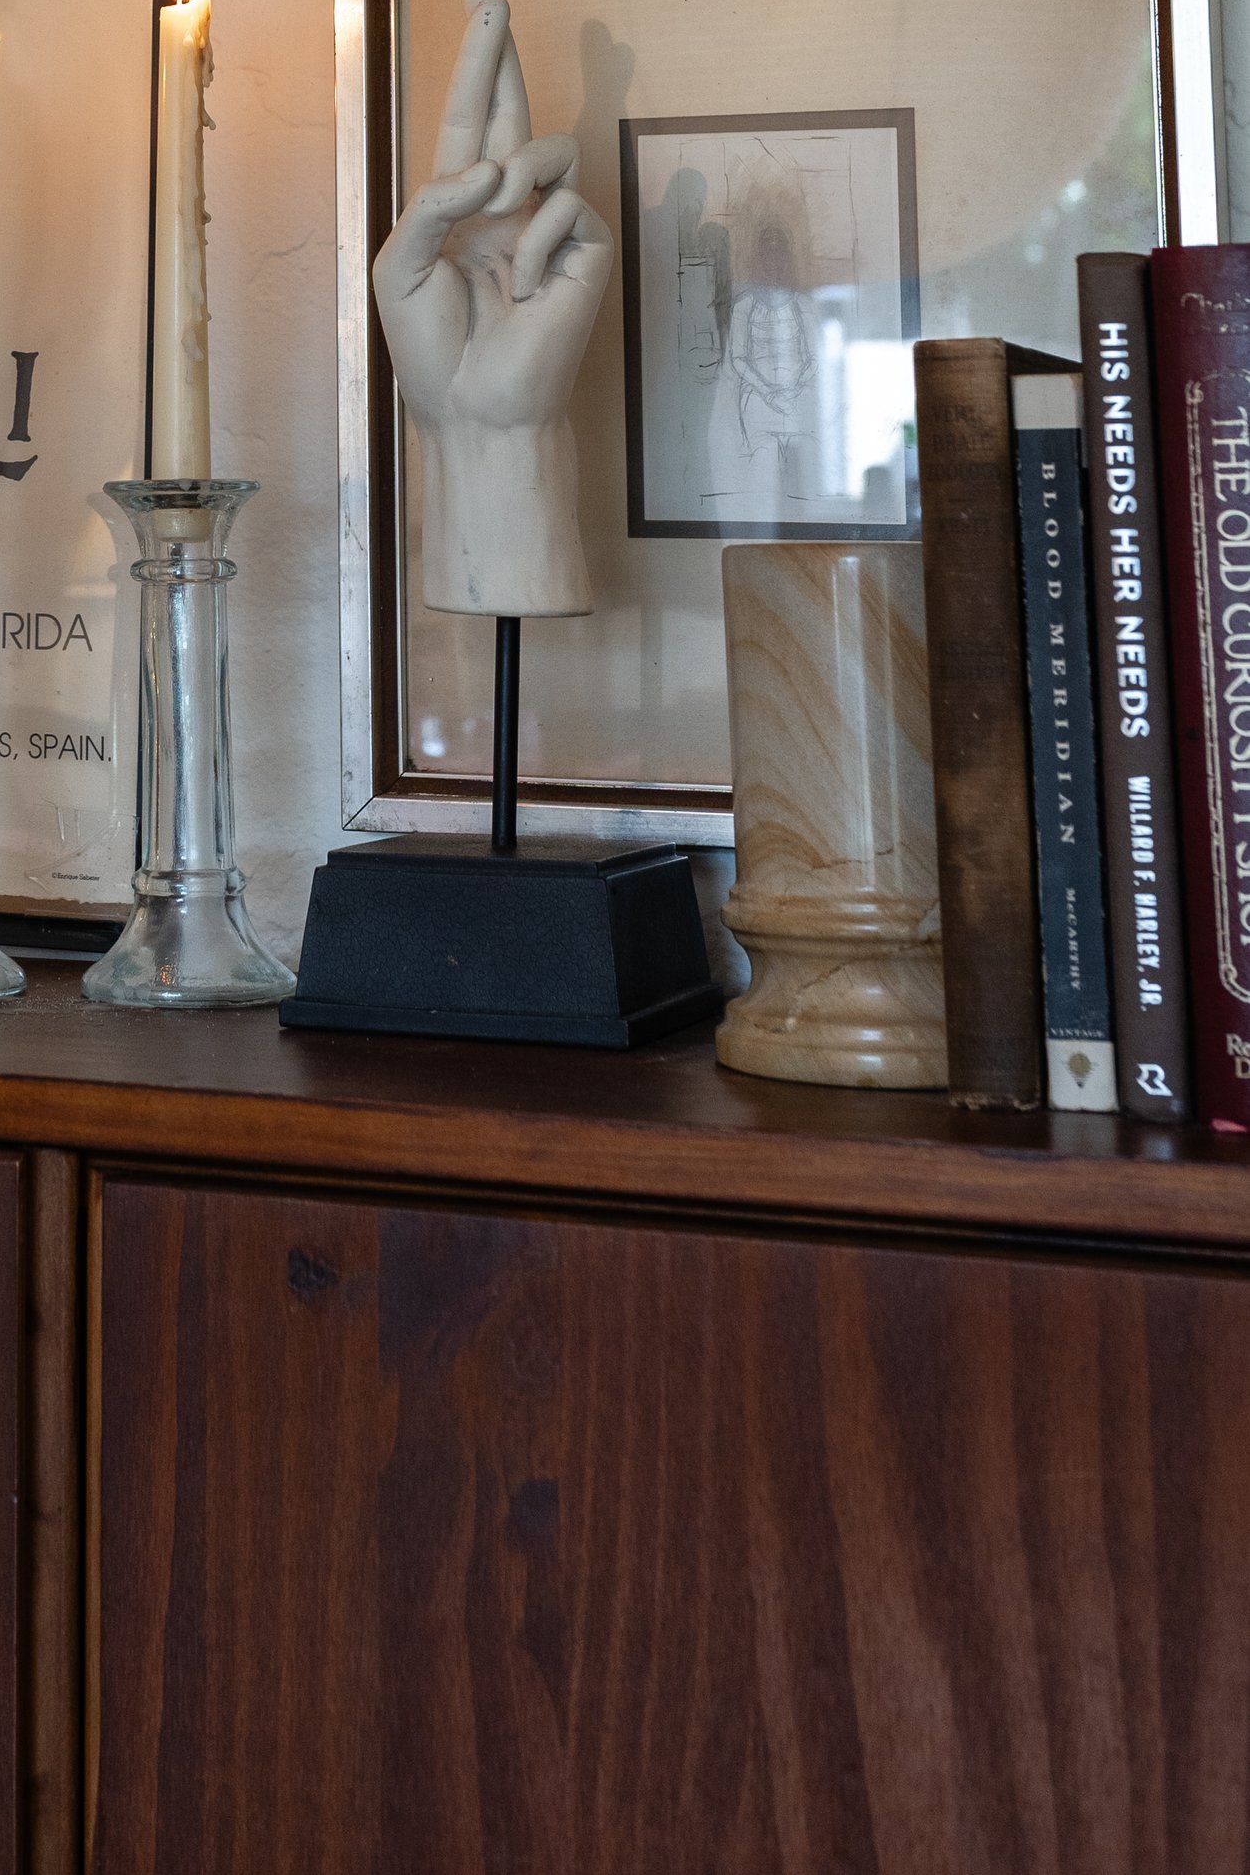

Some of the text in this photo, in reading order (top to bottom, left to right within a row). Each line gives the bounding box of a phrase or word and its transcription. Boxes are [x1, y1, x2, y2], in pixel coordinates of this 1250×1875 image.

[1211, 406, 1250, 502] THE
[1098, 322, 1151, 739] HIS NEEDS HER NEEDS
[1216, 509, 1250, 593] OLD
[1041, 461, 1076, 845] BLOOD MERIDIAN
[27, 733, 113, 762] SPAIN.
[1065, 887, 1081, 991] McCARTHY
[1127, 775, 1163, 1012] WILLARD F. HARLEY, JR.
